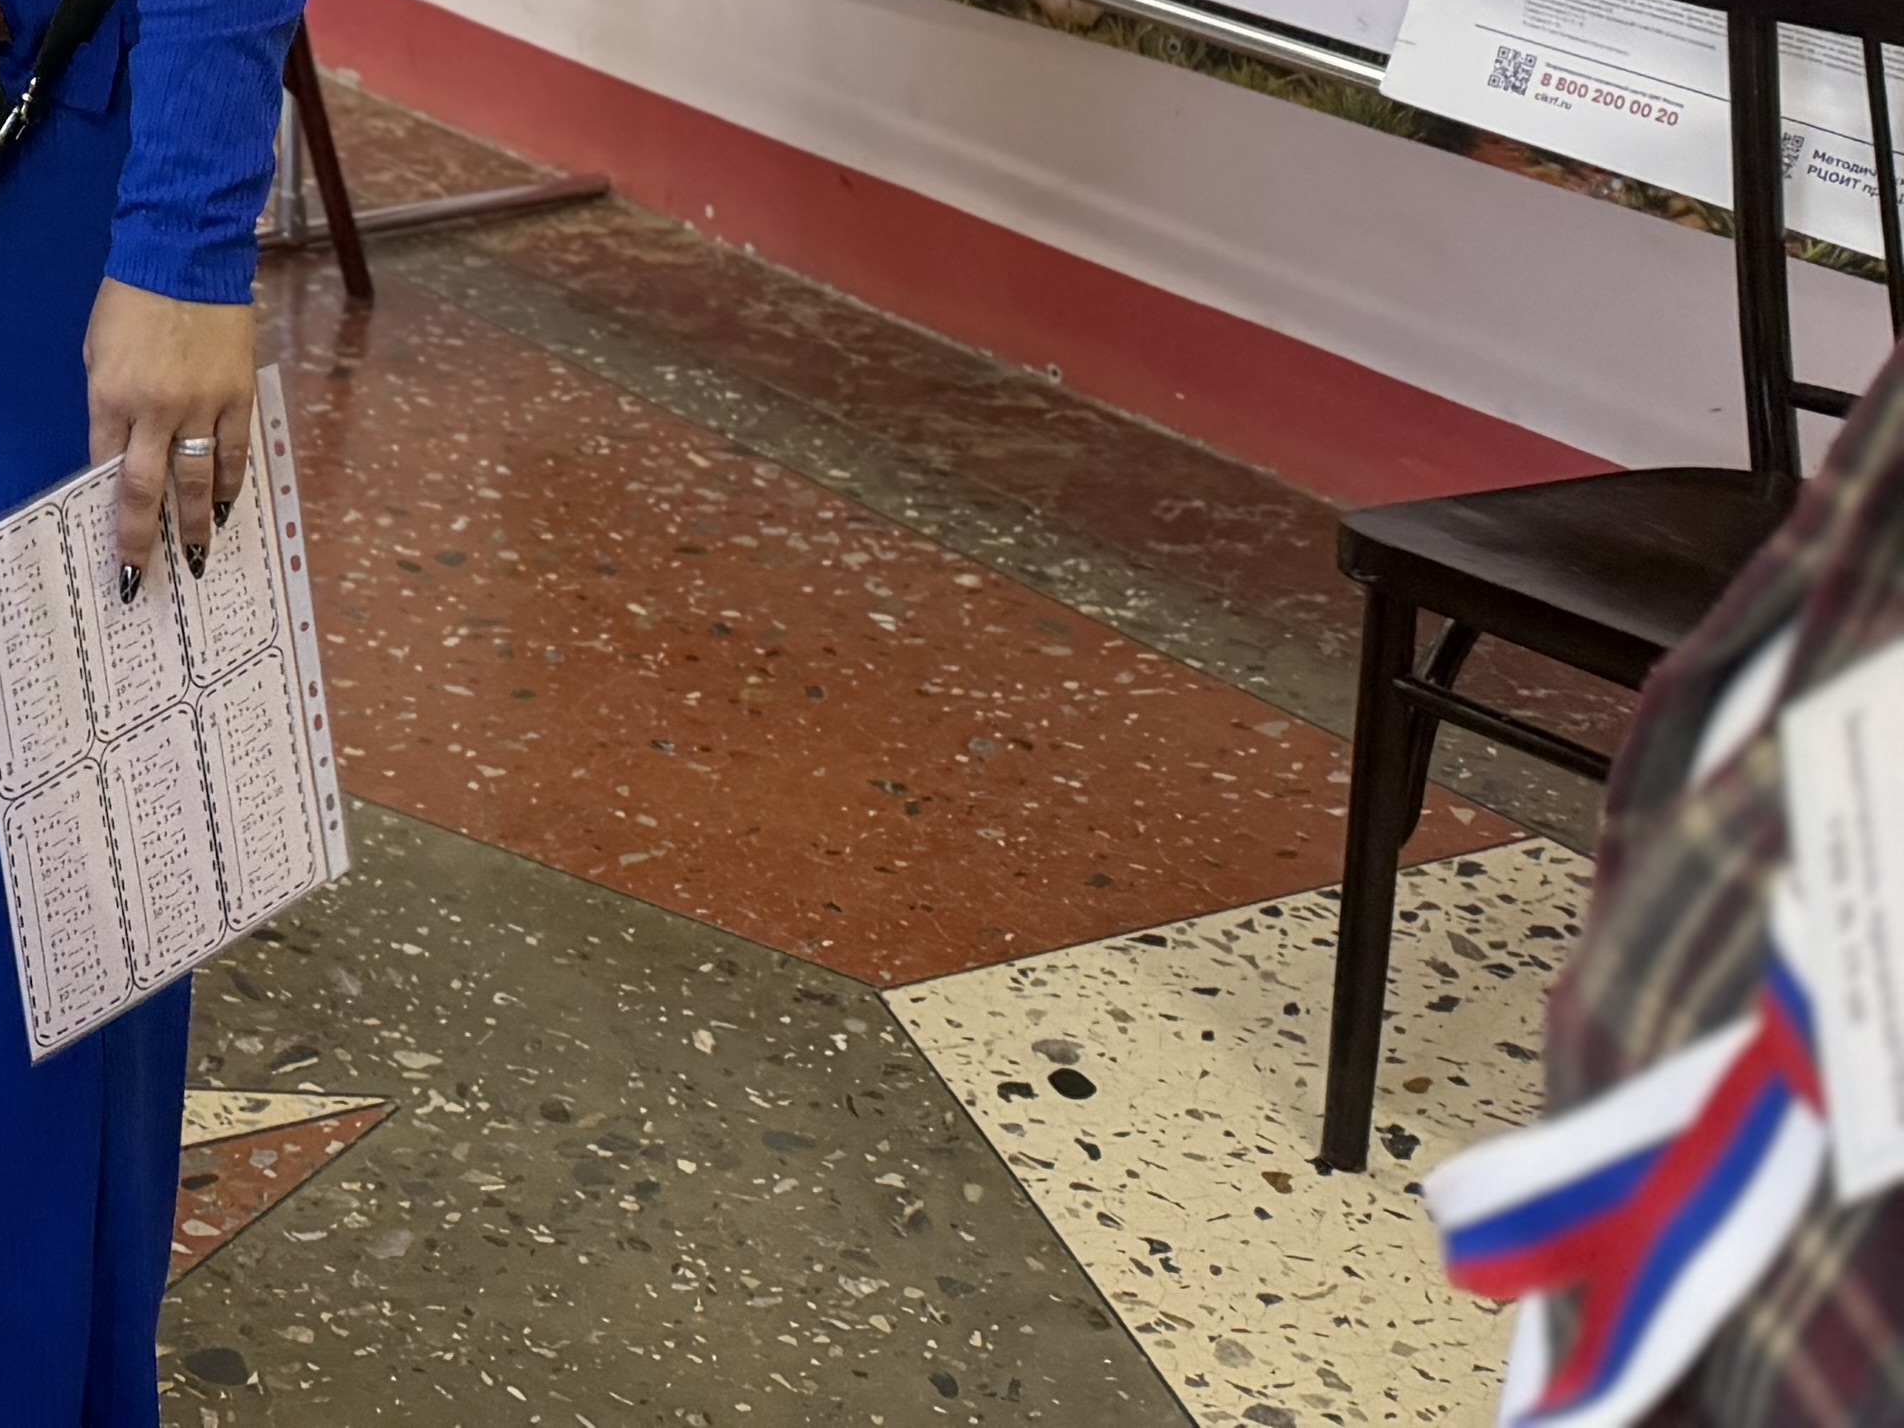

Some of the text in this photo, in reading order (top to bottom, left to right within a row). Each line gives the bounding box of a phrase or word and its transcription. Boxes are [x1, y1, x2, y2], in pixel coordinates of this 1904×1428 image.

[1540, 72, 1679, 127] 8 800 200 00 20
[1807, 164, 1862, 190] РЦОИТ
